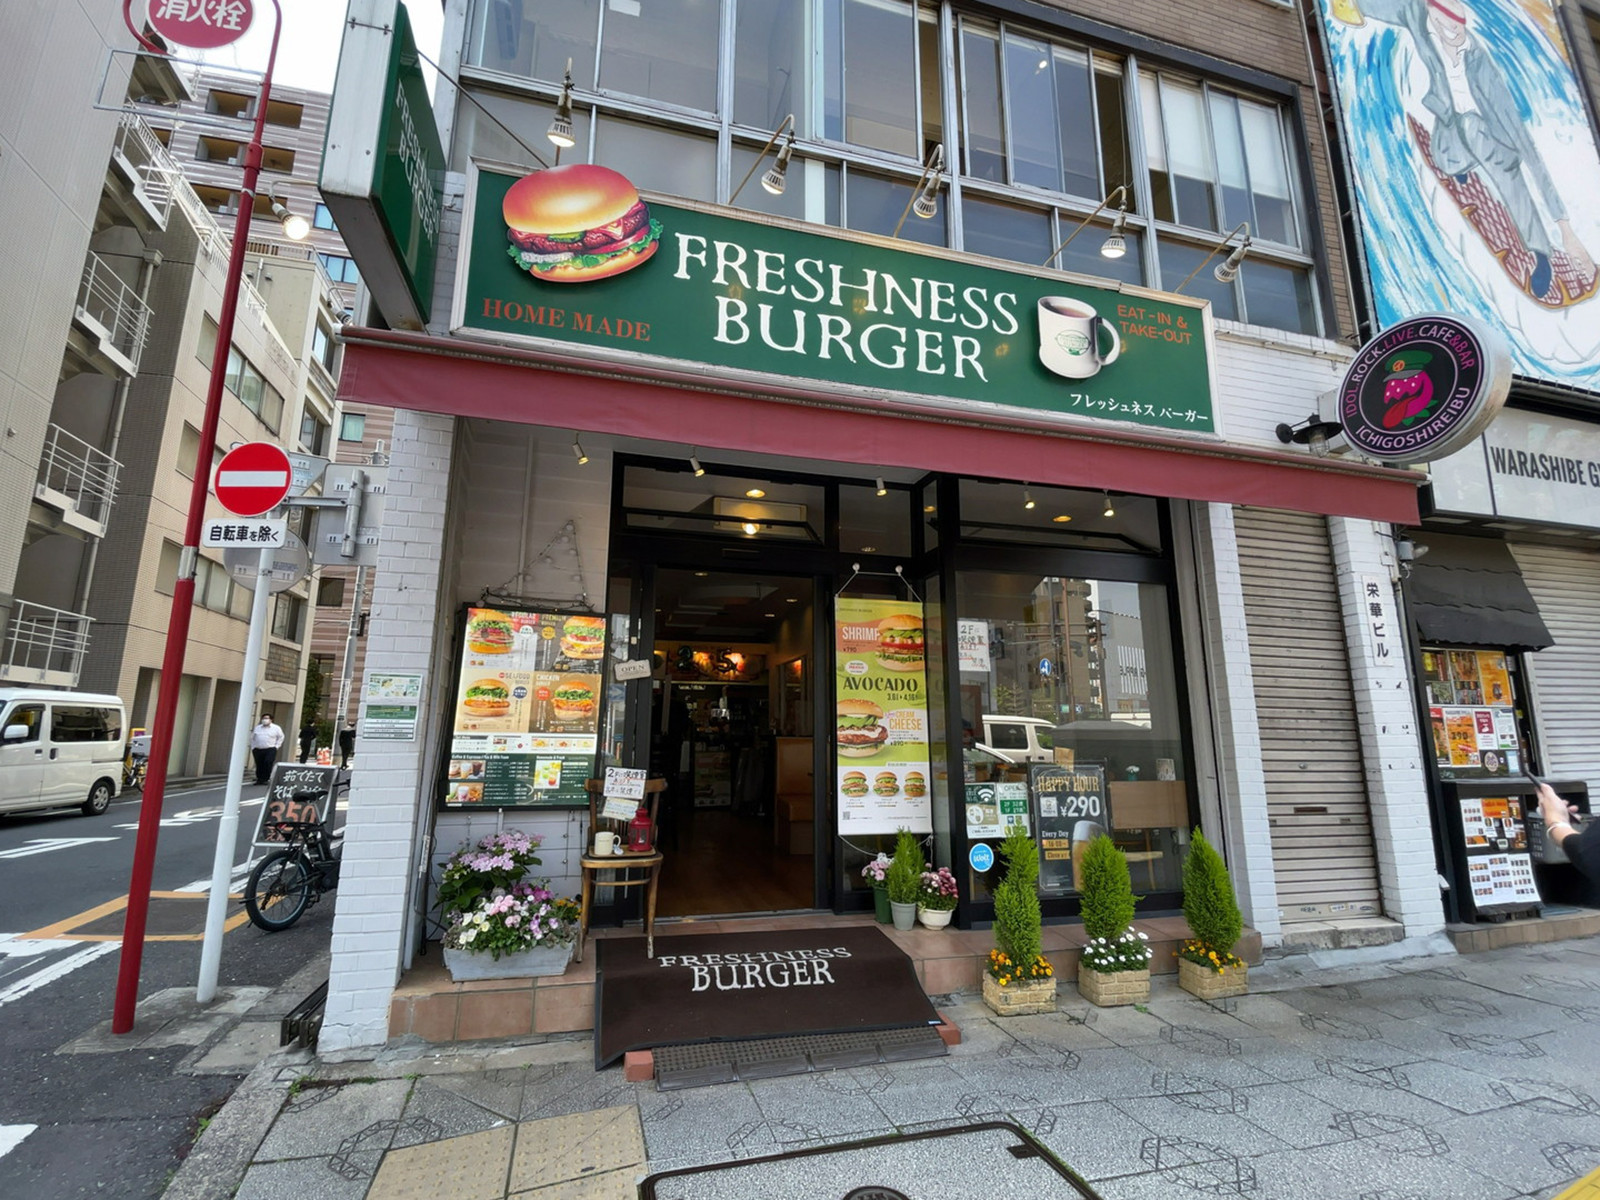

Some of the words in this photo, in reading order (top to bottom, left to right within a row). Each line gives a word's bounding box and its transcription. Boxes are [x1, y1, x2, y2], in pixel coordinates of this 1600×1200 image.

[155, 0, 247, 30] 消火栓
[396, 78, 440, 234] FRESHNESS
[399, 133, 433, 248] BURGER
[673, 232, 1019, 336] FRESHNESS
[482, 298, 565, 328] HOME
[573, 313, 650, 342] MADE
[713, 295, 988, 383] BURGER
[1120, 321, 1192, 345] TAKE-OUT
[1070, 393, 1155, 417] フレッシュネス
[1159, 406, 1208, 423] バーガー
[1355, 387, 1470, 449] ICHIGOSHIREIBU
[1490, 446, 1587, 487] WARASHIBE
[1588, 460, 1600, 489] G
[209, 525, 279, 543] 自転車を除く
[1366, 582, 1389, 658] 栄華ビル
[842, 626, 881, 641] SHRIMP
[621, 664, 645, 673] OPEN
[843, 677, 918, 692] AVOCADO
[889, 718, 923, 731] CHEESE
[896, 711, 915, 719] CREAM
[283, 770, 325, 783] 茹でたて
[1037, 775, 1071, 792] HAPPY
[1073, 775, 1100, 792] HOUR
[273, 785, 298, 799] そば
[1060, 796, 1100, 817] ¥290
[1058, 830, 1069, 838] Day
[657, 947, 852, 968] FRESHNESS
[690, 959, 835, 991] BURGER
